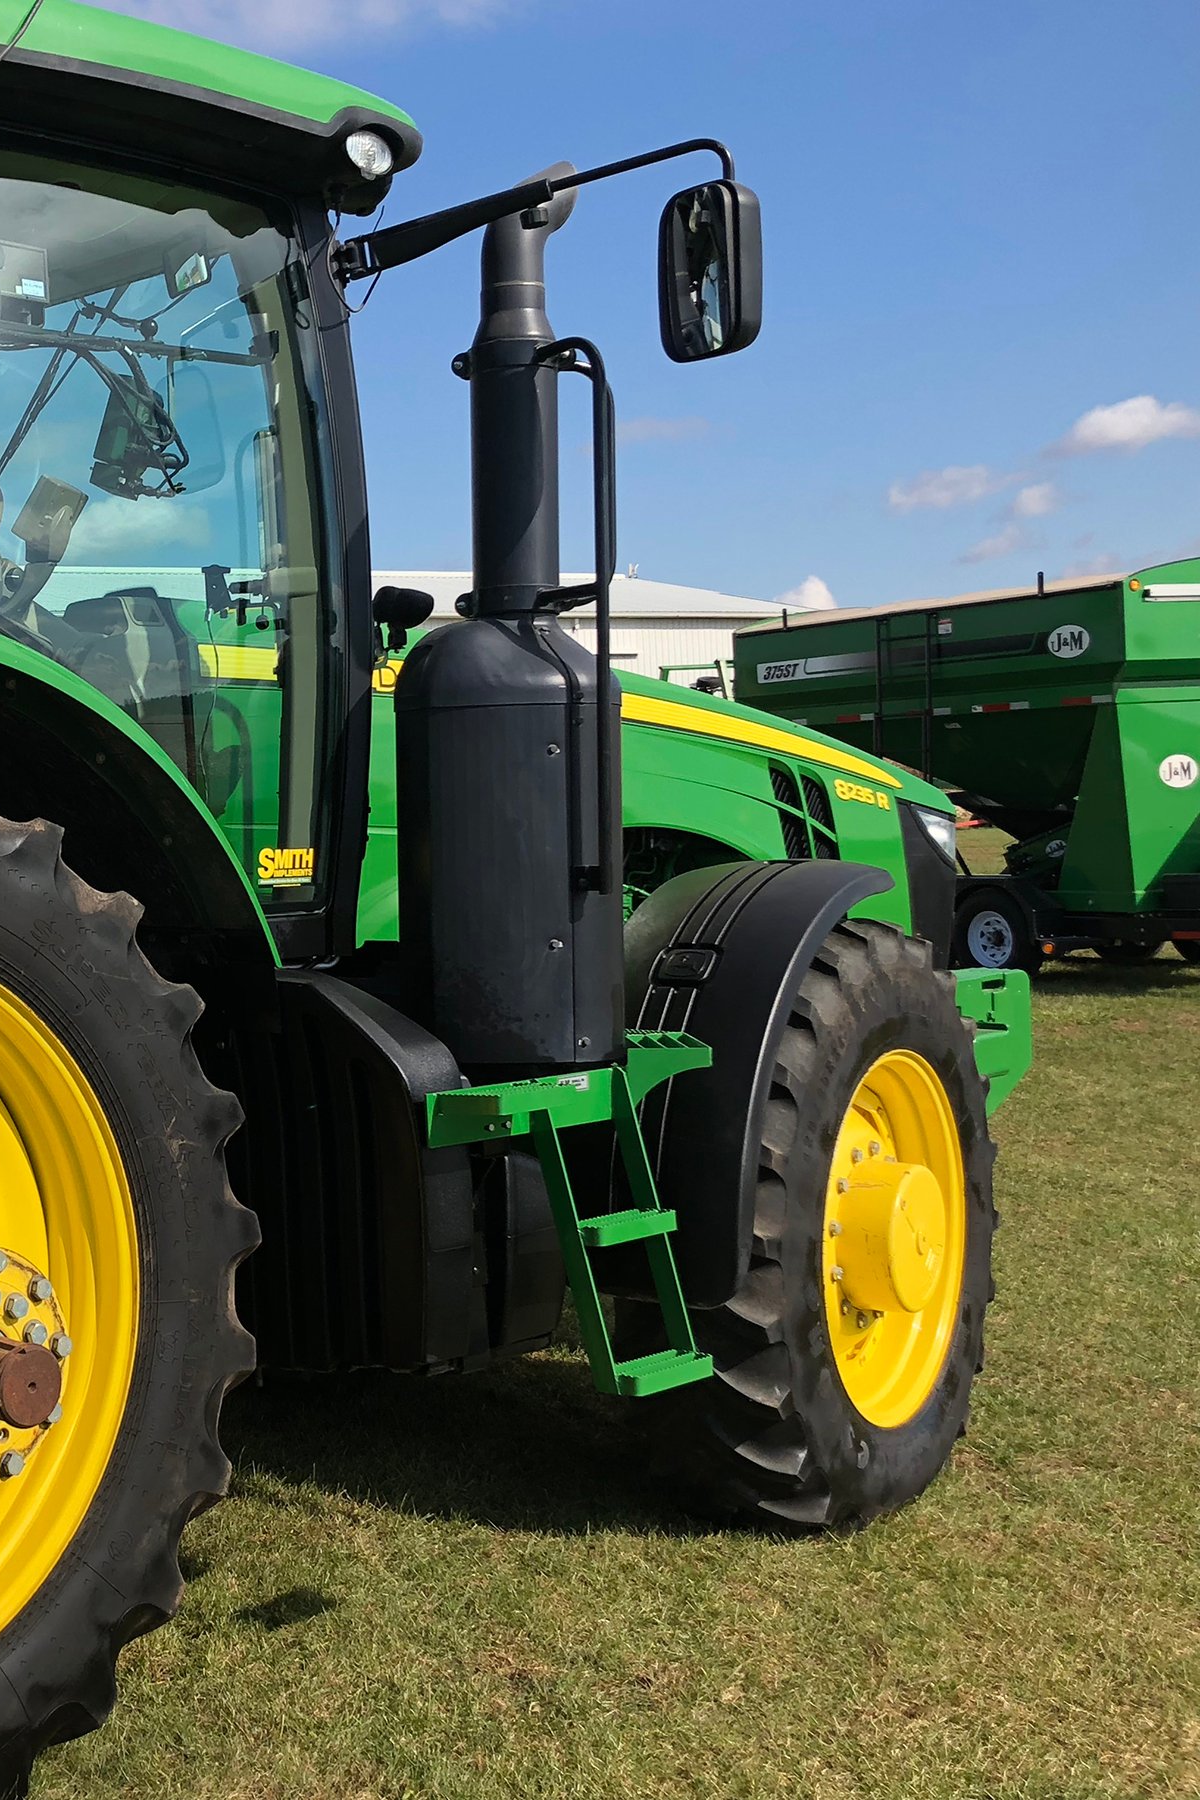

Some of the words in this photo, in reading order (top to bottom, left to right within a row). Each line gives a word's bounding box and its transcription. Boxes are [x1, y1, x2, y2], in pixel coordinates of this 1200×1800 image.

[1050, 630, 1085, 653] J&M
[763, 663, 800, 680] 375ST
[1162, 761, 1192, 782] J&M
[257, 847, 314, 879] SMITH
